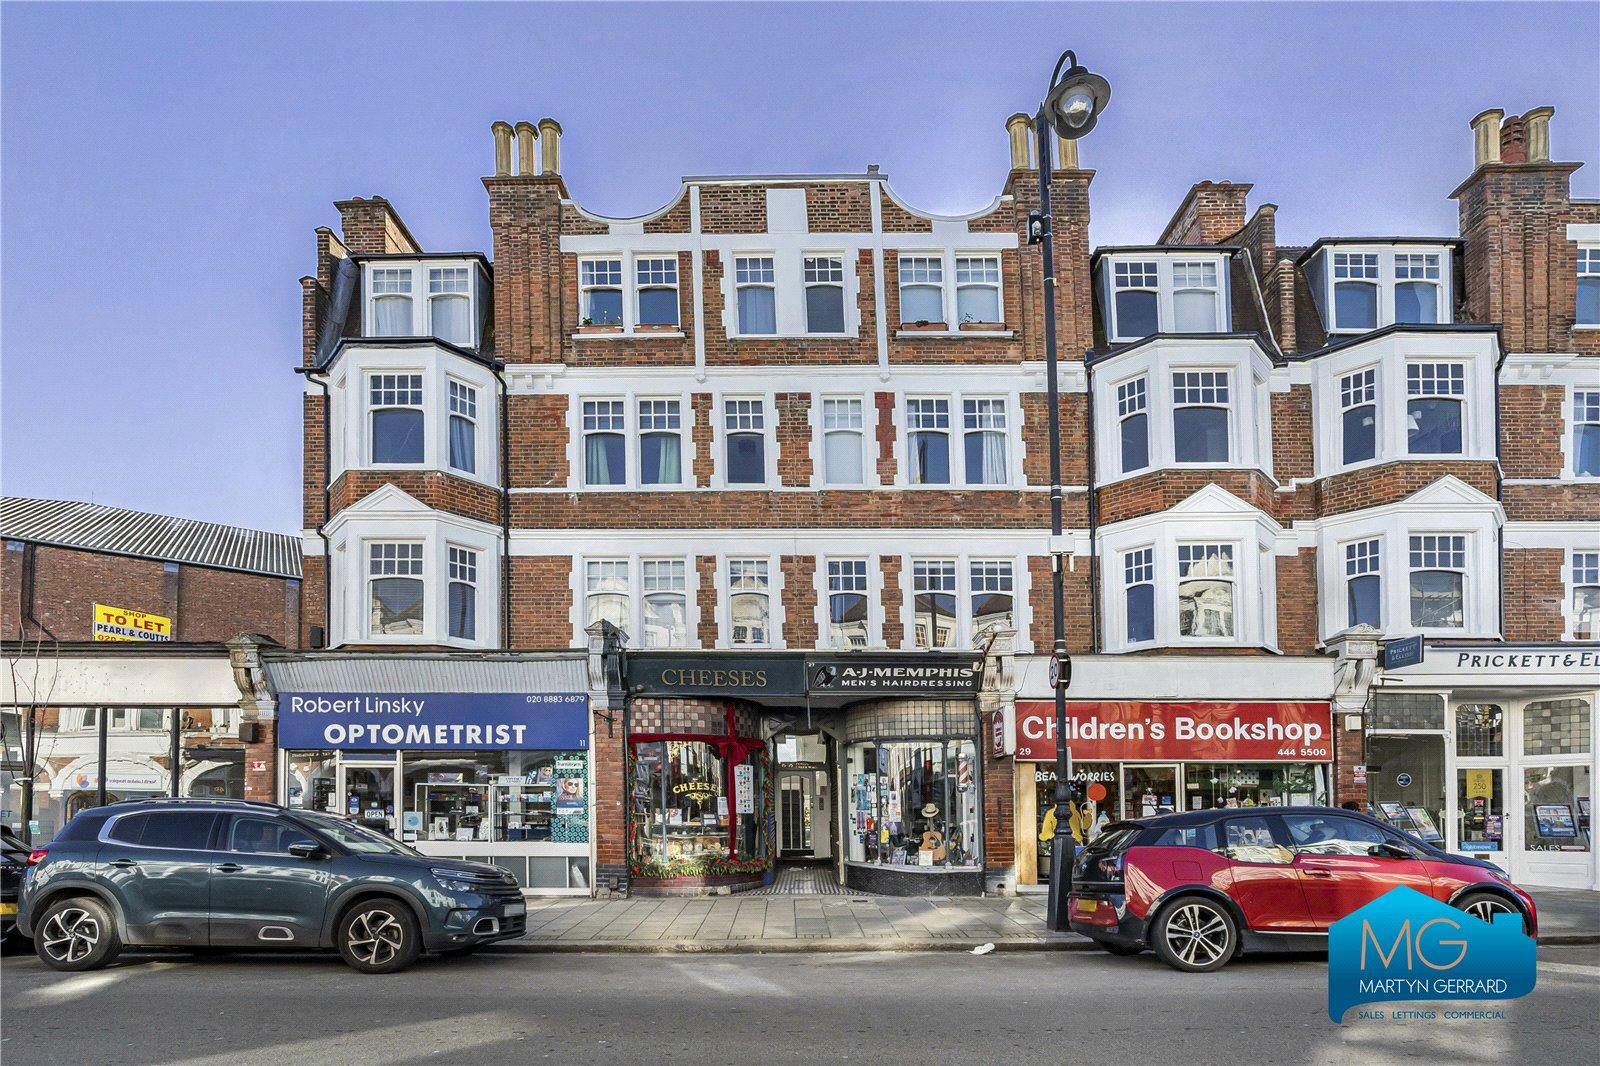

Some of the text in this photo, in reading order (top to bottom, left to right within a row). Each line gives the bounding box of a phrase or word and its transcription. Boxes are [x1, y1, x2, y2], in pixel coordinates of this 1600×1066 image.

[103, 613, 164, 632] TO LET
[123, 610, 147, 618] SHOP
[97, 624, 127, 636] PEARL
[138, 631, 169, 642] COUTTS
[661, 668, 767, 687] CHEESES
[1051, 663, 1058, 680] 20
[882, 679, 973, 687] HAIRDRESSING
[291, 696, 425, 716] Robert Linsky
[323, 723, 527, 745] OPTOMETRIST
[1022, 715, 1165, 740] Children's
[1175, 716, 1322, 746] Bookshop
[579, 739, 586, 747] 11
[1019, 747, 1032, 756] 29
[1277, 748, 1327, 756] 444 5500
